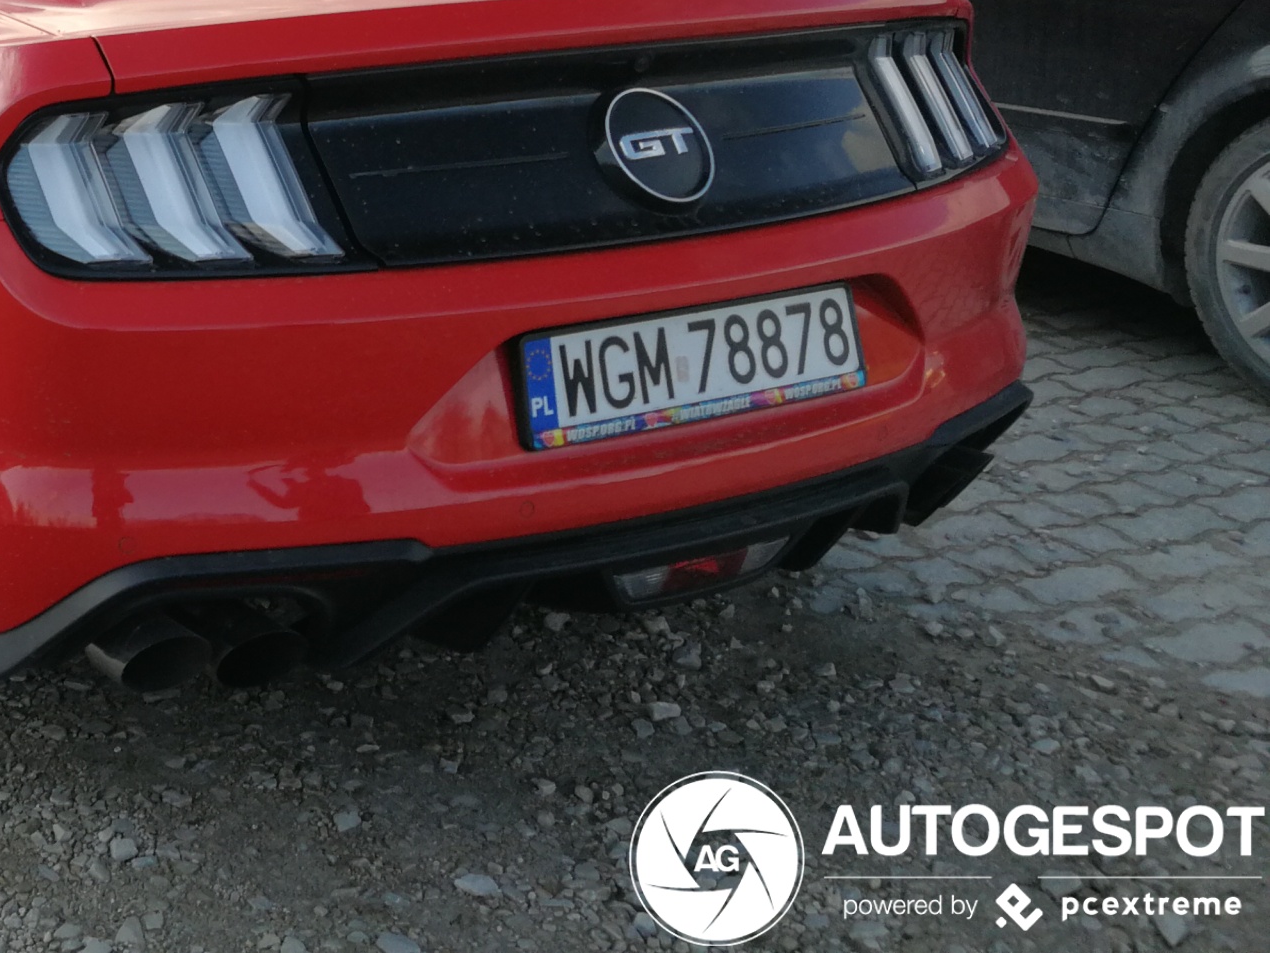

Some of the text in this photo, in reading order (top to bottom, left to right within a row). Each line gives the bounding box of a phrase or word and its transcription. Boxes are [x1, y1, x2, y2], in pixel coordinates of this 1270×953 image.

[620, 127, 693, 160] GT
[558, 298, 850, 417] WGM 78878
[531, 396, 555, 419] PL
